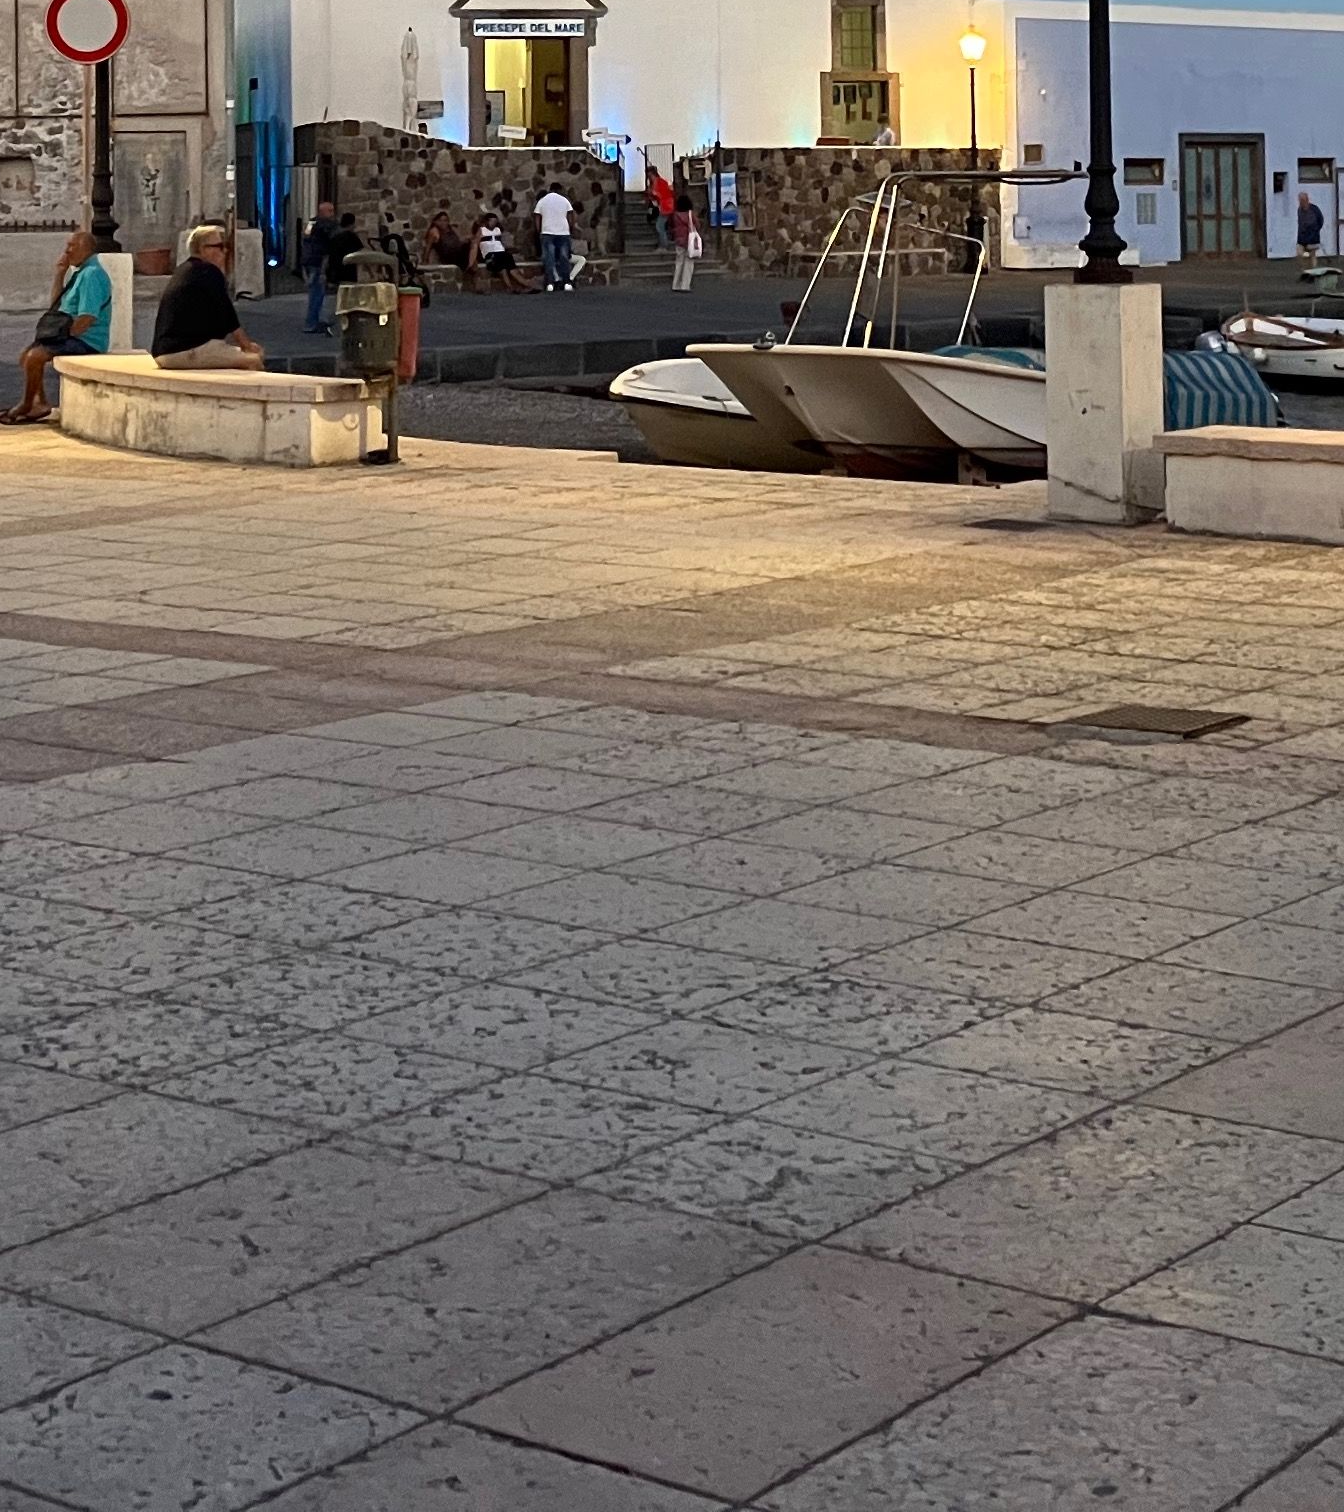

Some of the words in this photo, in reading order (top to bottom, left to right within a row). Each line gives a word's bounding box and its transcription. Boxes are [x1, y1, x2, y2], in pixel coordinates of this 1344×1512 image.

[475, 23, 526, 33] PRESEPE
[529, 23, 552, 33] DEL
[554, 23, 584, 33] MARE
